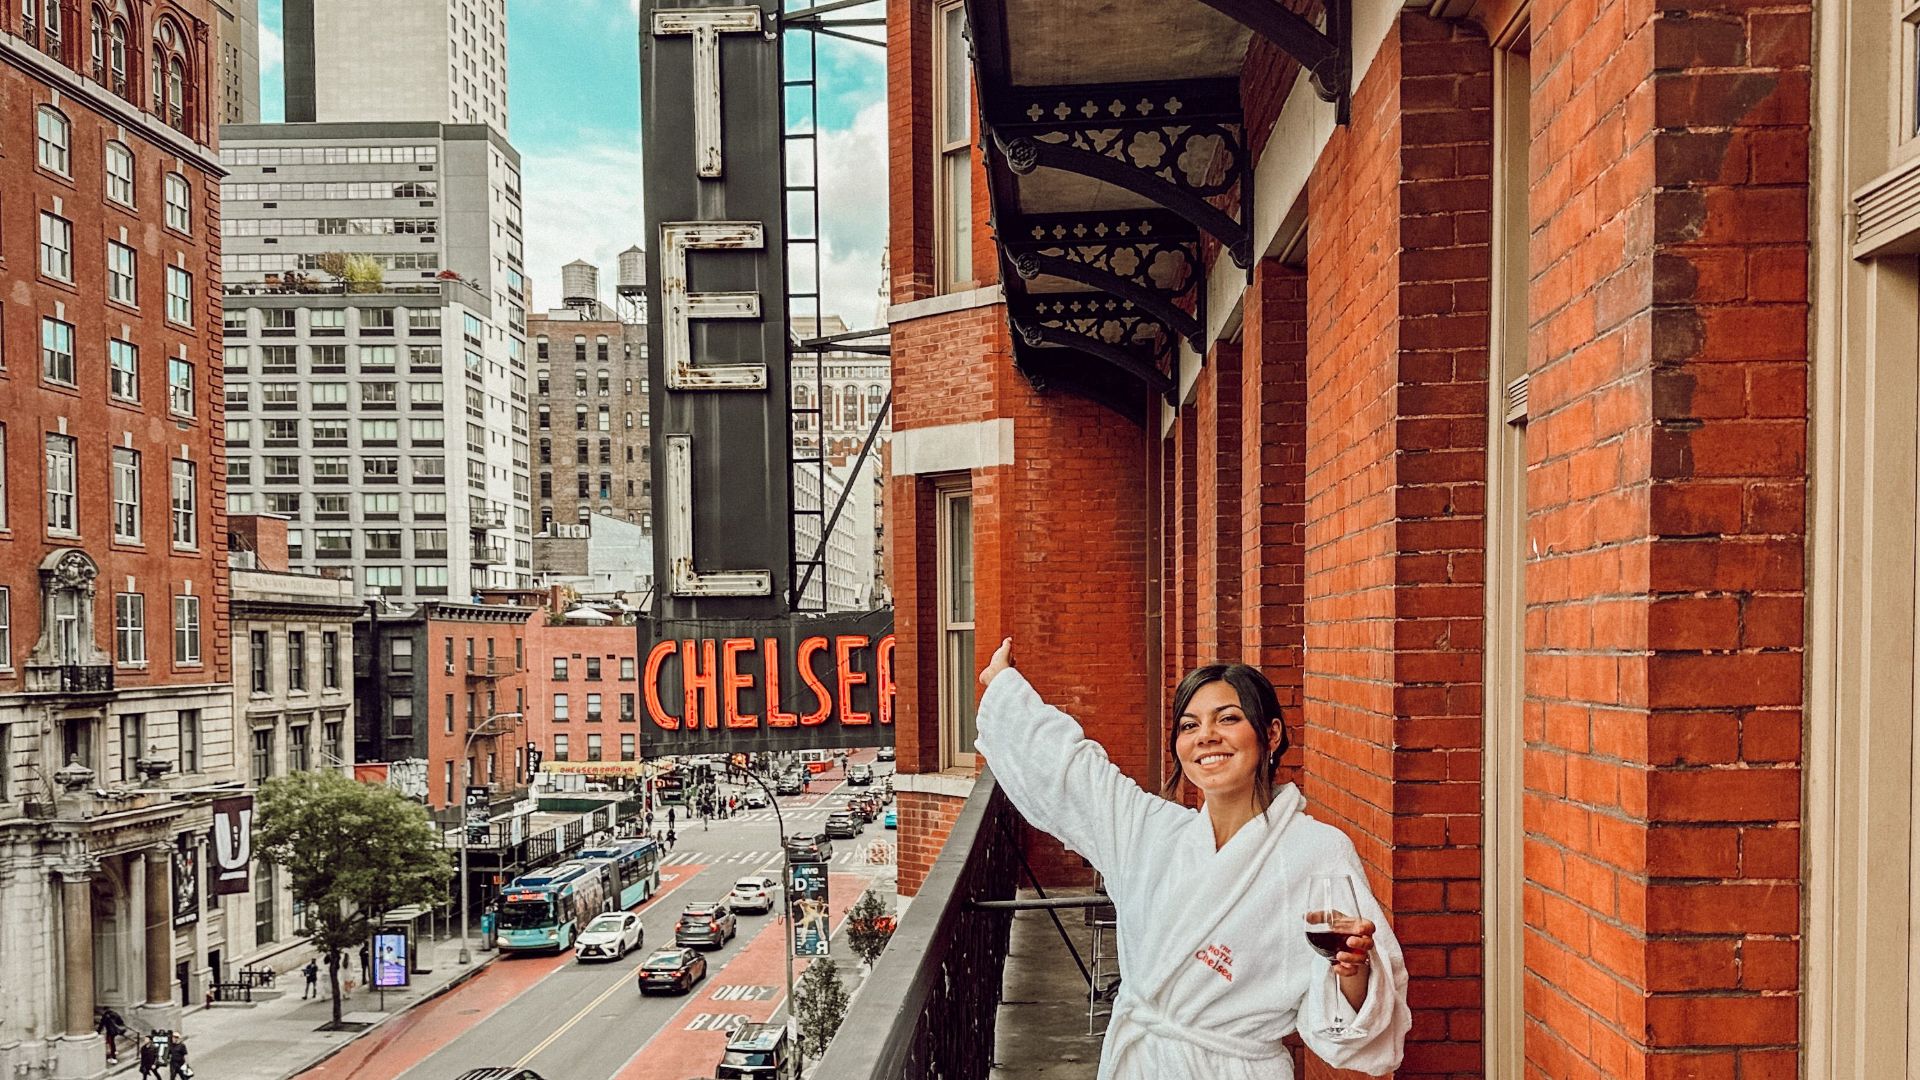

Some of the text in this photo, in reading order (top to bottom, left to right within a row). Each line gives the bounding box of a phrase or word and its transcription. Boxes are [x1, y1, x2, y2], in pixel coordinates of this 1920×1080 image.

[1208, 945, 1232, 966] HOTEL
[1195, 950, 1232, 982] Chelsea
[710, 985, 779, 1000] ONLY
[684, 1013, 750, 1031] BUS
